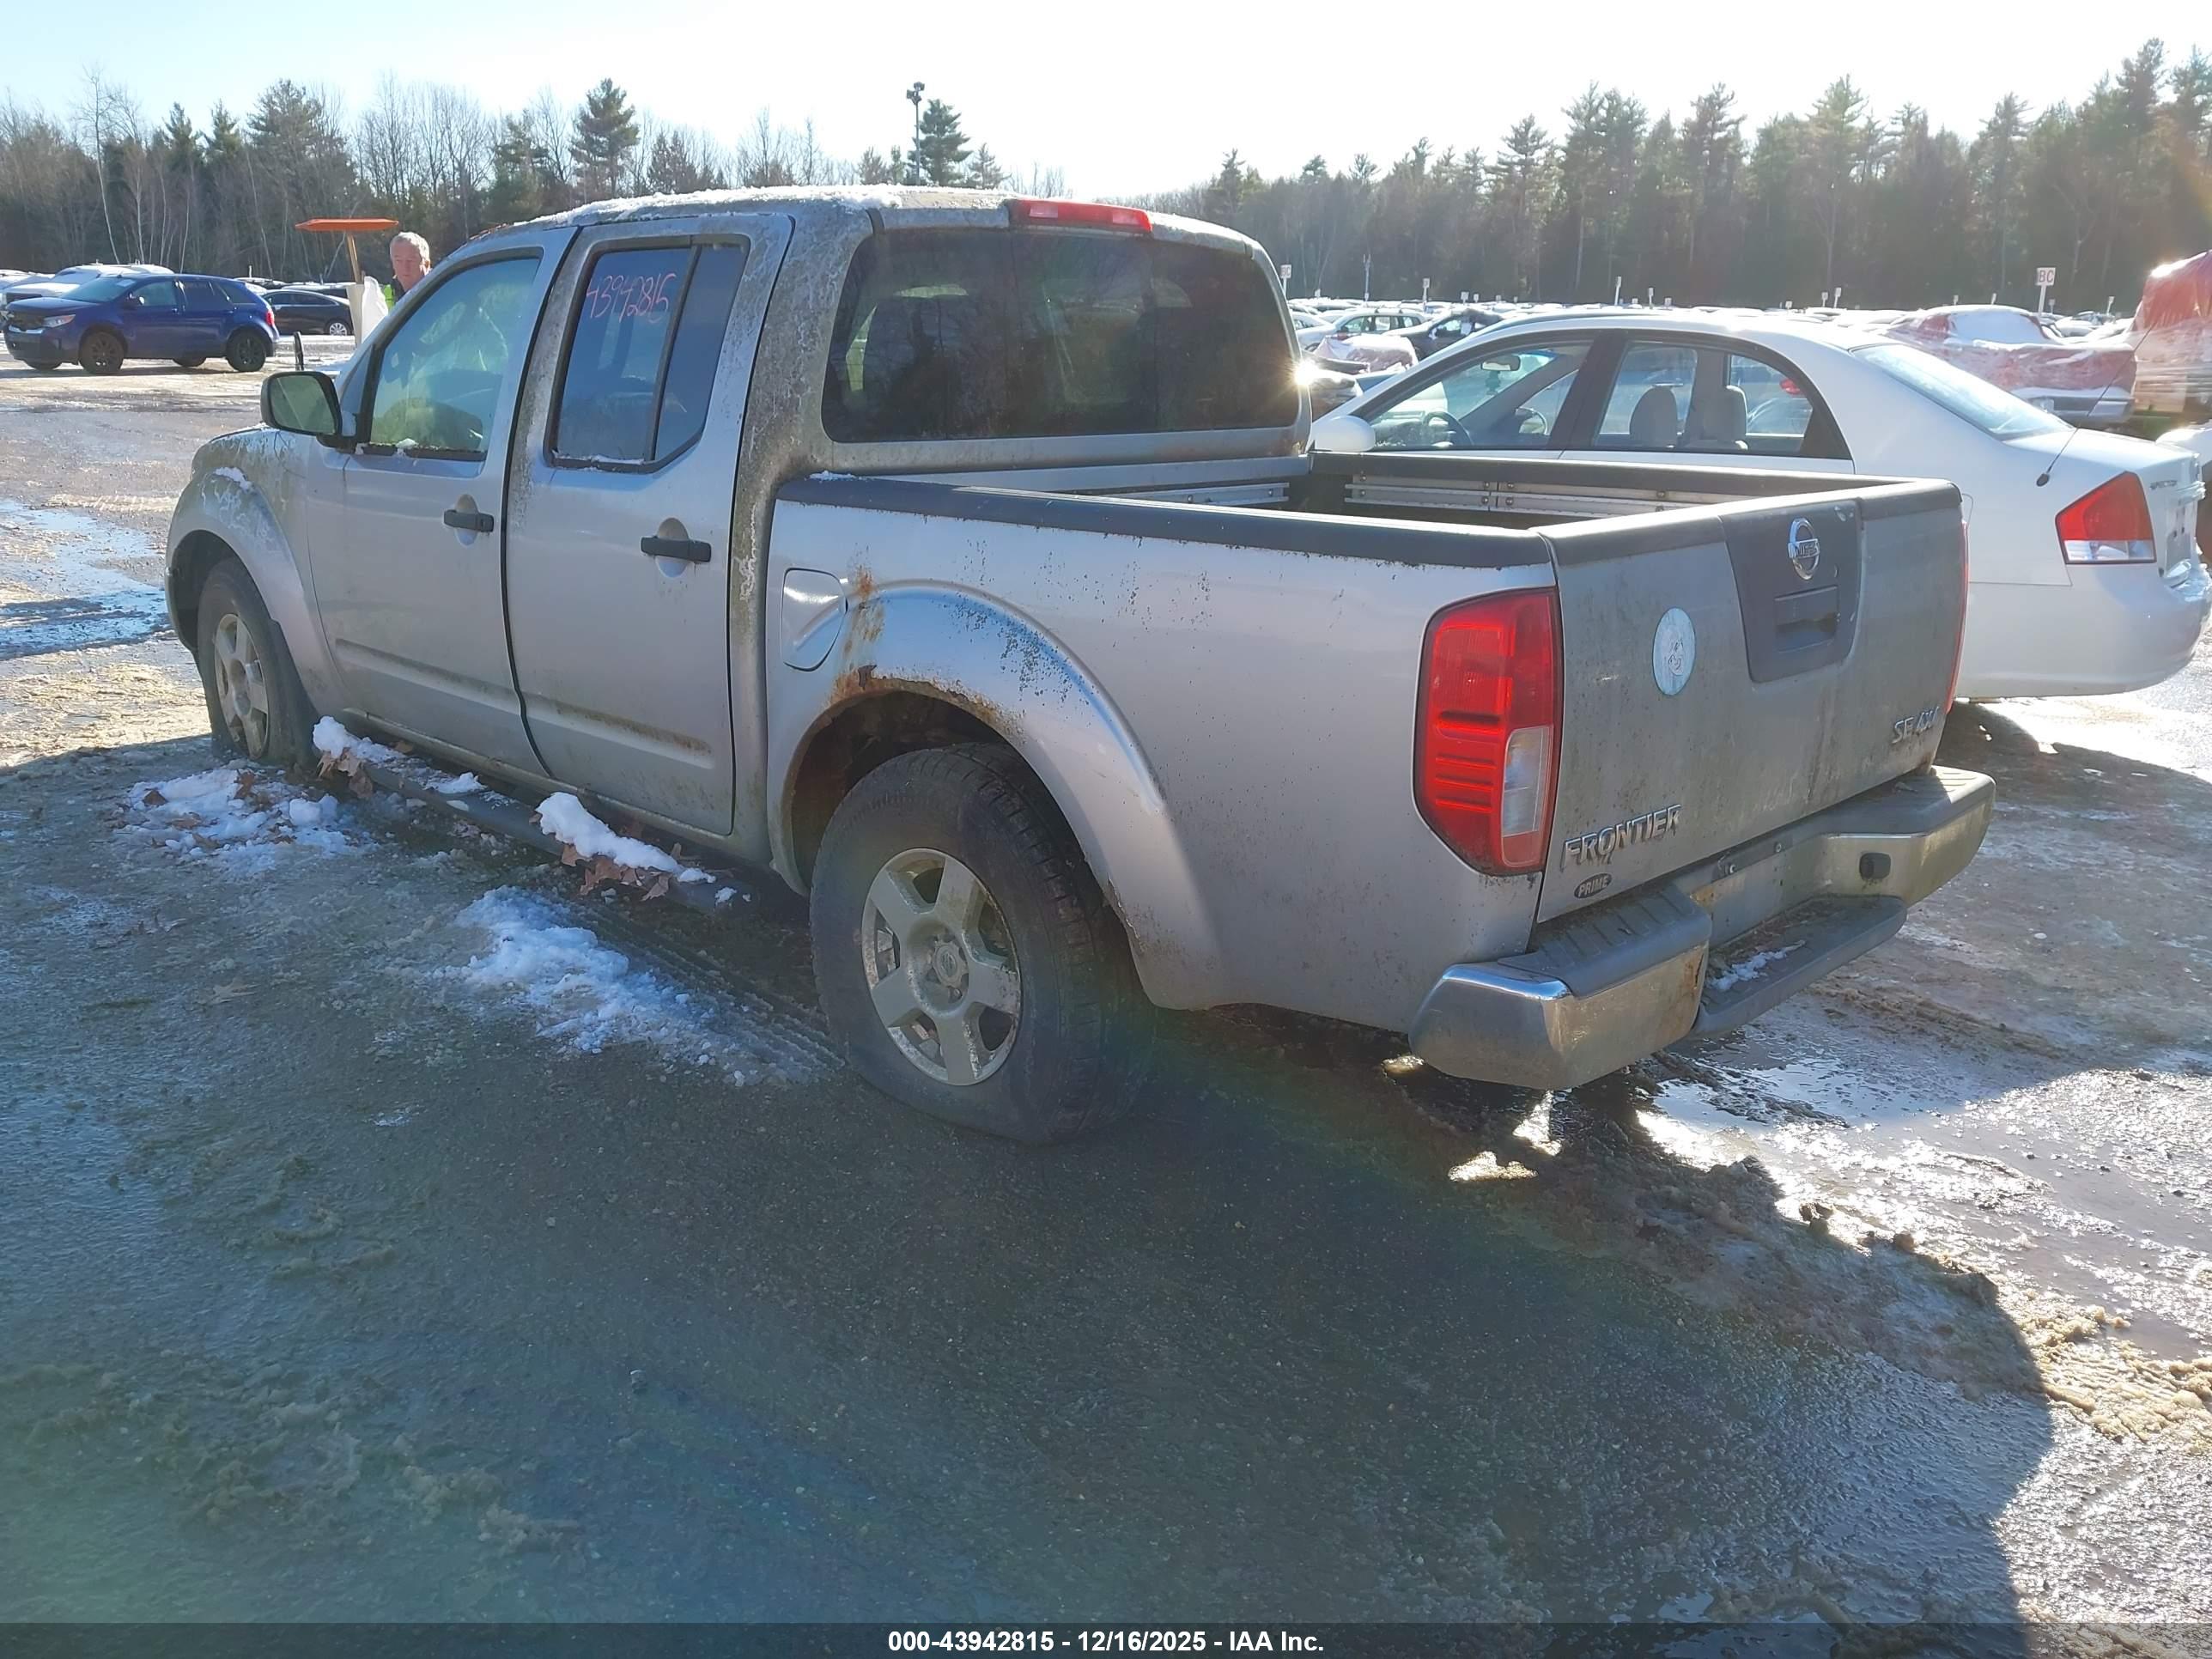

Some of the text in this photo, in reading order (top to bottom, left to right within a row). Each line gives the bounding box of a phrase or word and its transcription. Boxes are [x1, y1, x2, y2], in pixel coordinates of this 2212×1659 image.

[2039, 270, 2054, 283] BC
[1892, 716, 1914, 744] SE
[1562, 804, 1681, 868] FRONTIER
[1577, 873, 1609, 897] PRIME
